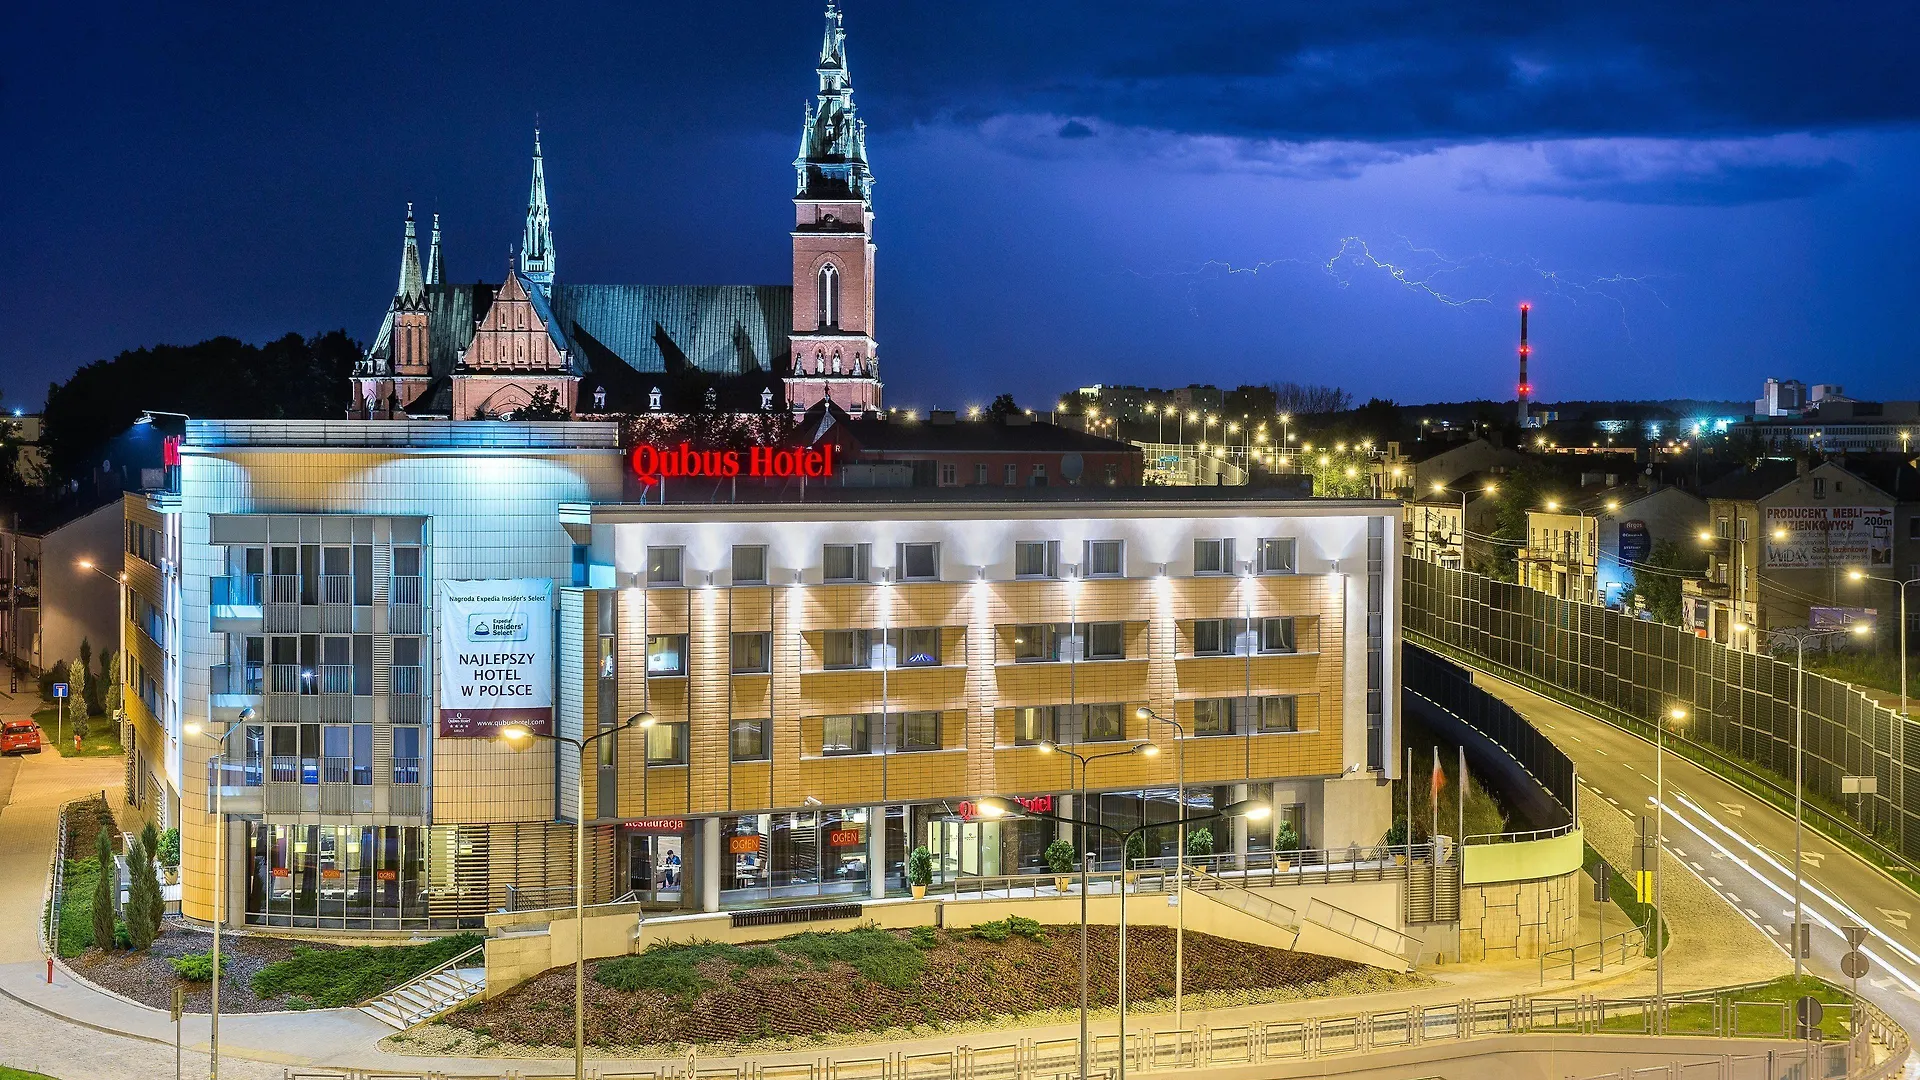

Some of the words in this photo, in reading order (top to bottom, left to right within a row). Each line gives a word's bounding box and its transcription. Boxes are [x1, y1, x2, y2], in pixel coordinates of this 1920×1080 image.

[632, 443, 740, 486] Qubus
[749, 443, 833, 477] Hotel
[1767, 508, 1828, 519] PRODUCENT
[1833, 508, 1863, 518] MEBLI
[1864, 516, 1892, 526] 200m
[476, 595, 500, 603] Expedia
[459, 653, 536, 667] NAJLEPSZY
[474, 669, 522, 681] HOTEL
[461, 685, 474, 697] W
[479, 684, 533, 697] POLSCE
